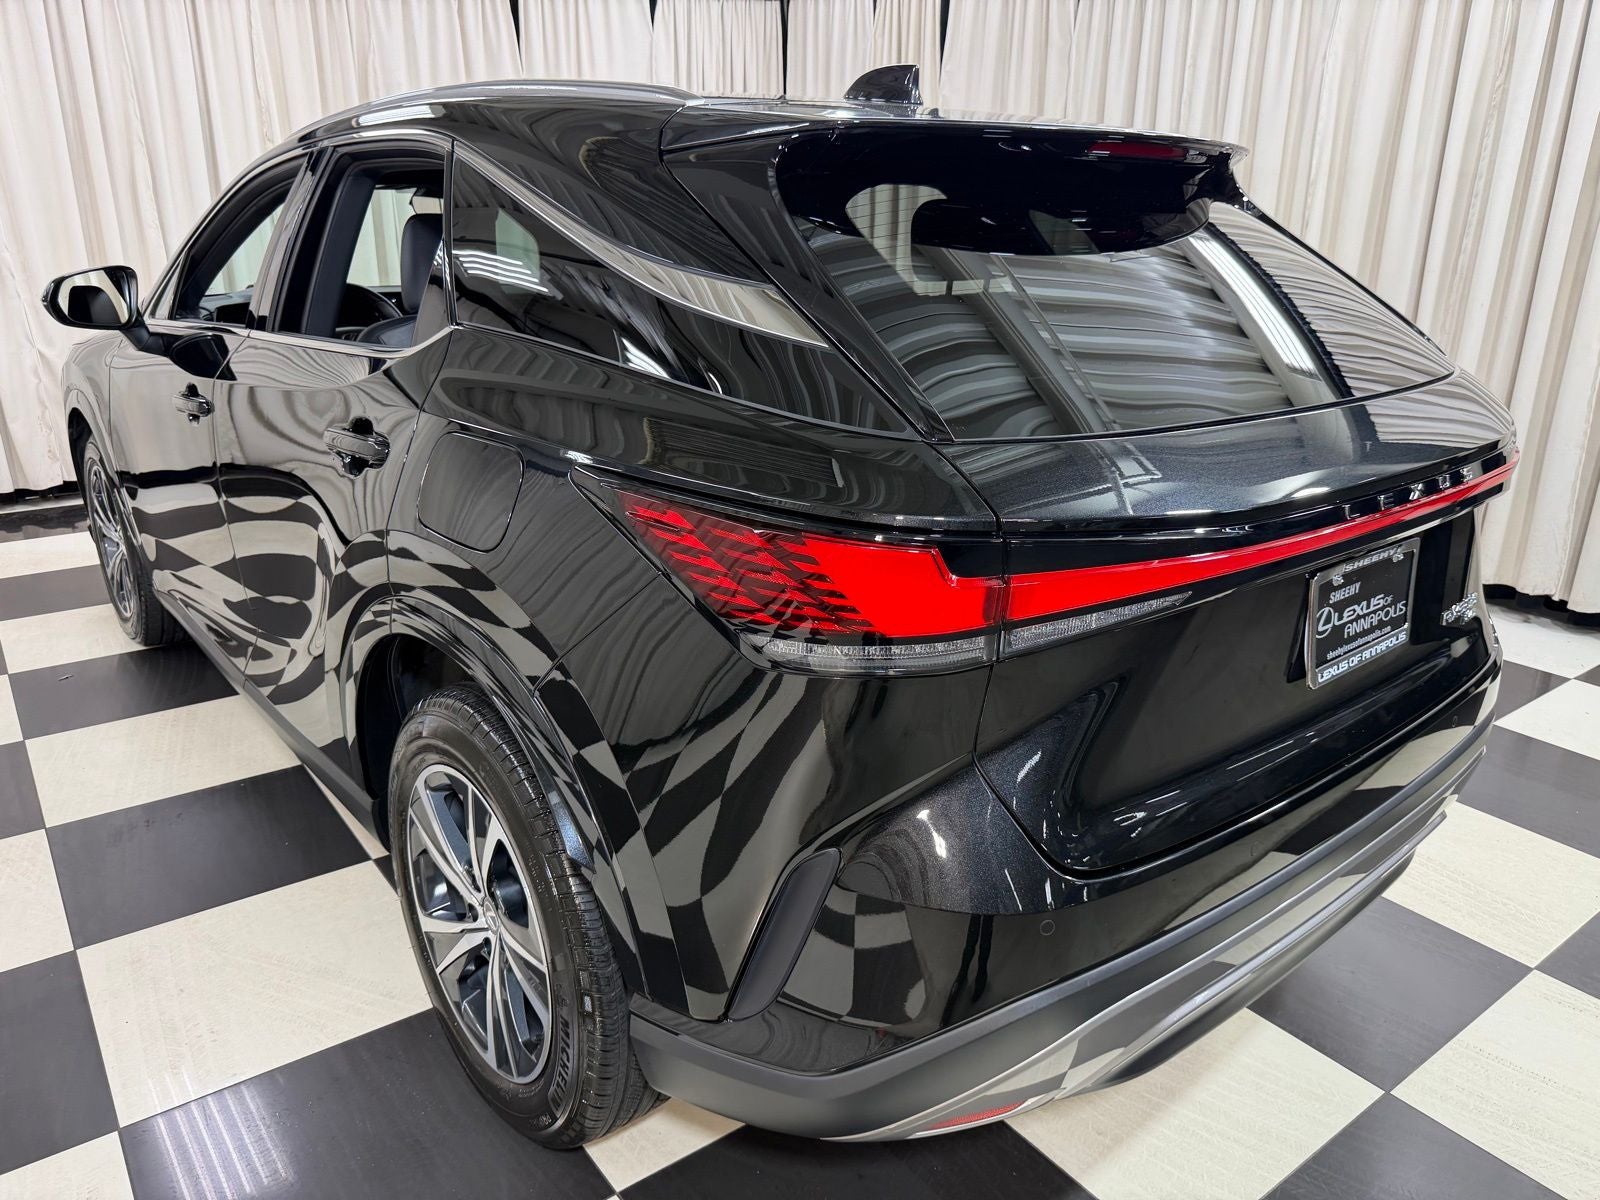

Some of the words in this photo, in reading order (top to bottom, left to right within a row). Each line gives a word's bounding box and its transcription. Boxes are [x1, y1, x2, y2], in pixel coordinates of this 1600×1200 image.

[1343, 466, 1473, 520] LEXUS
[1345, 547, 1397, 572] SHEEHY
[1329, 581, 1361, 604] SHEEHY
[1334, 593, 1385, 625] LEXUS
[1344, 600, 1406, 638] ANNAPOLIS
[1318, 660, 1348, 683] LEXUS
[1348, 653, 1362, 668] OF
[1362, 631, 1407, 660] ANNAPOLIS
[550, 1014, 571, 1112] MICHELIN
